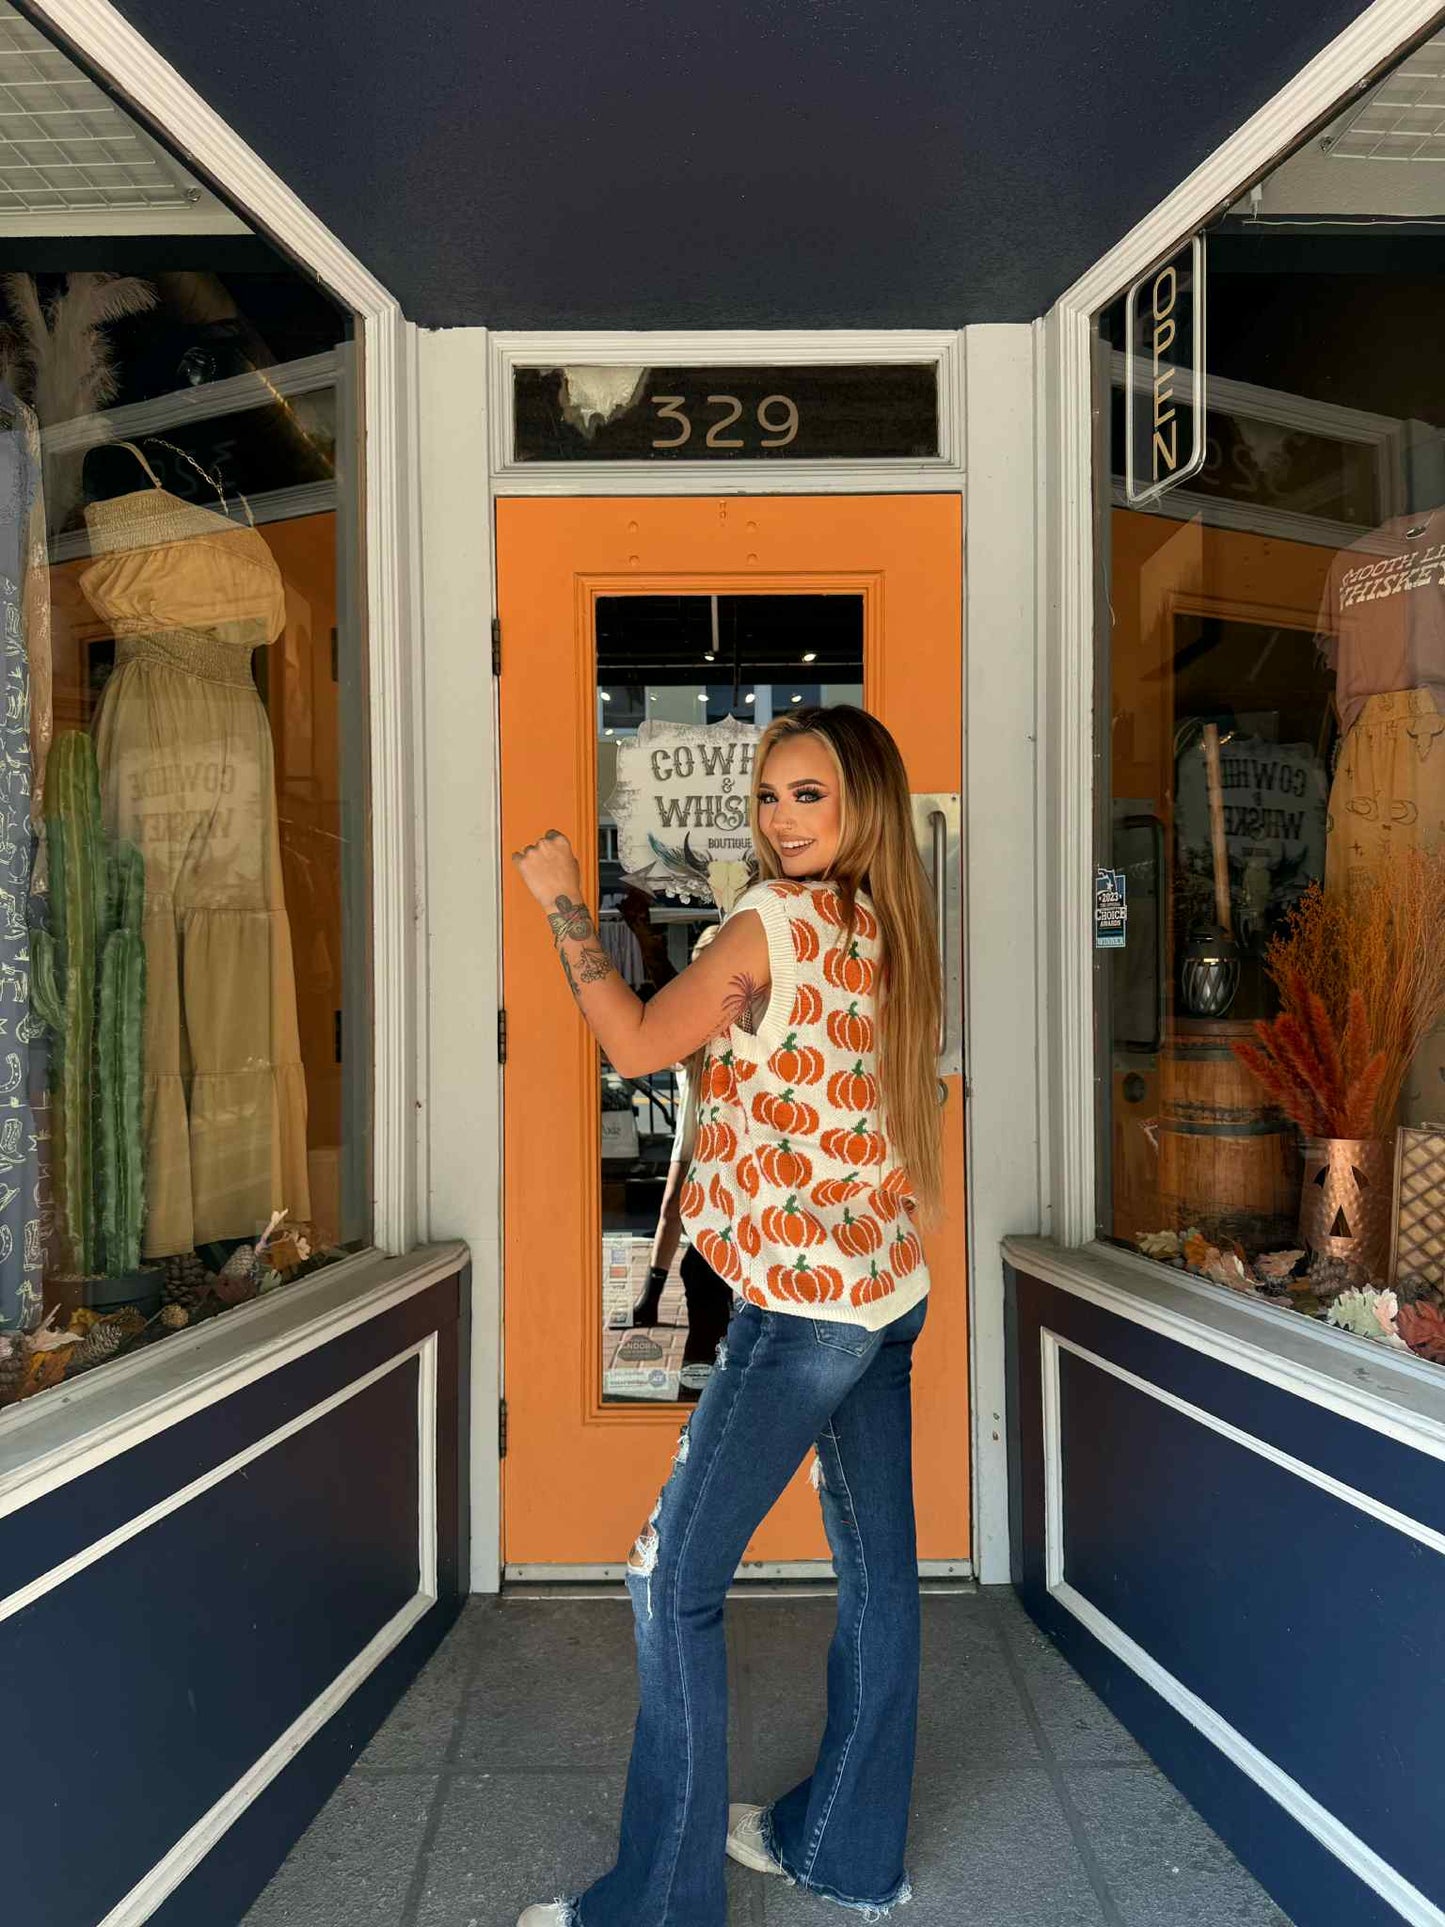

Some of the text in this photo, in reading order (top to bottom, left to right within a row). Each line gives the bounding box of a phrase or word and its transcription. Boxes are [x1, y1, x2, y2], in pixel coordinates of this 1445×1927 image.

[1152, 265, 1177, 482] OPEN
[651, 394, 800, 448] 329
[651, 742, 757, 781] COWH
[722, 777, 736, 794] &
[655, 795, 750, 831] WHIS
